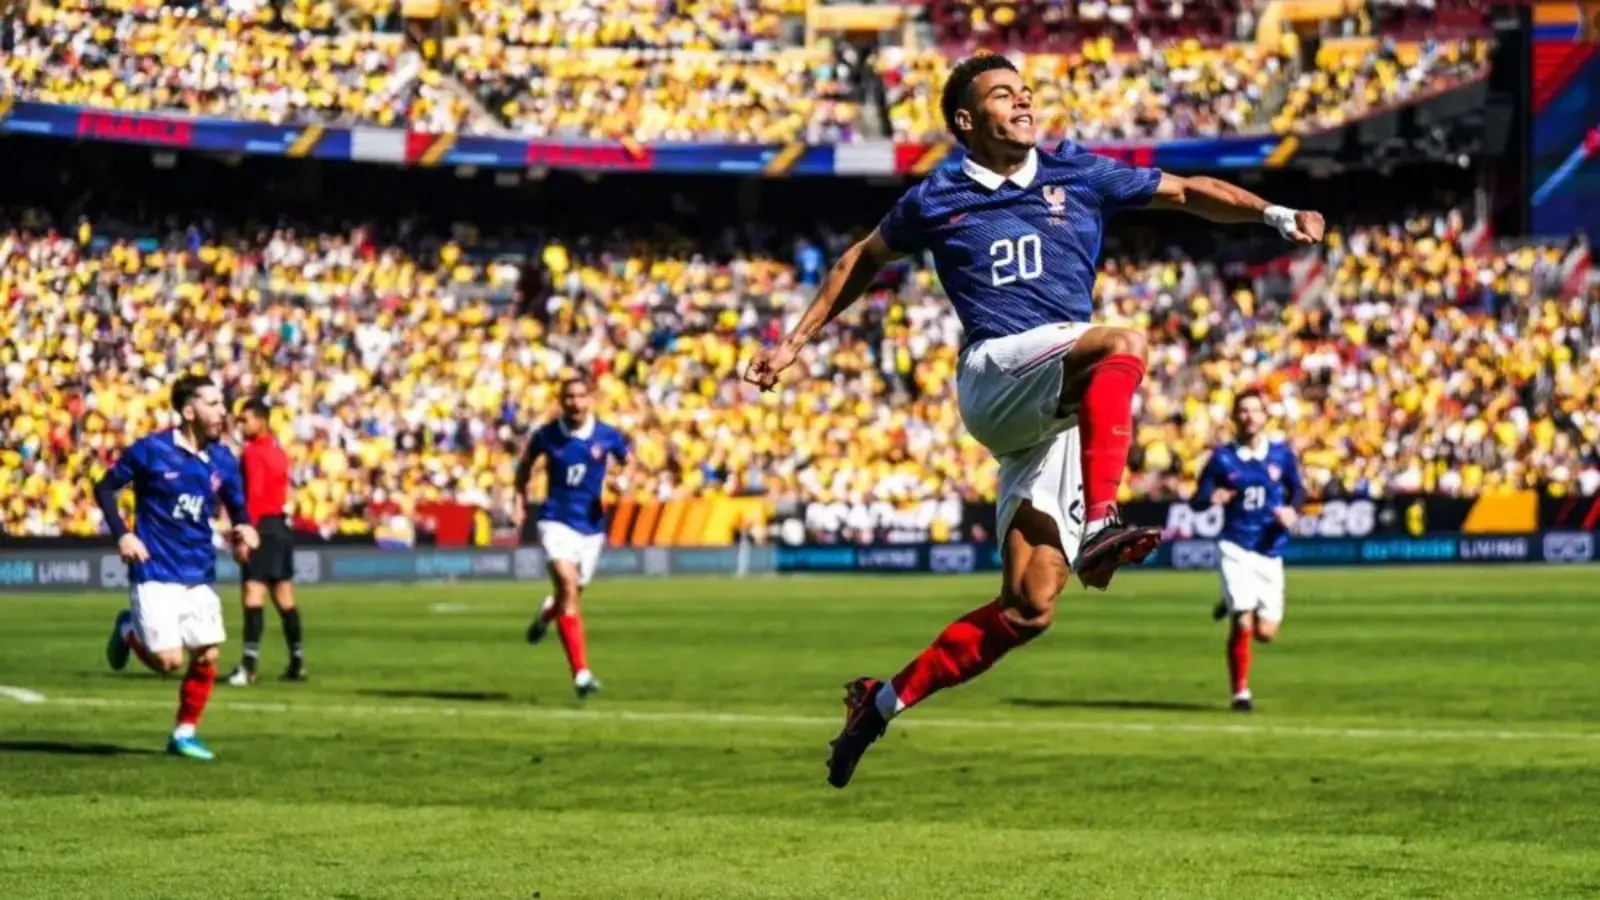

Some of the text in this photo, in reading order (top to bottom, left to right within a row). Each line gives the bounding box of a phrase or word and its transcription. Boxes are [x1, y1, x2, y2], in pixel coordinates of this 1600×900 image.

[77, 110, 192, 146] FRANCE
[989, 233, 1043, 287] 20
[566, 463, 587, 487] 17
[172, 493, 204, 522] 24
[1243, 486, 1265, 511] 21
[1362, 538, 1456, 559] OUTDOOR
[1460, 537, 1527, 559] LIVING
[38, 559, 90, 583] LIVING
